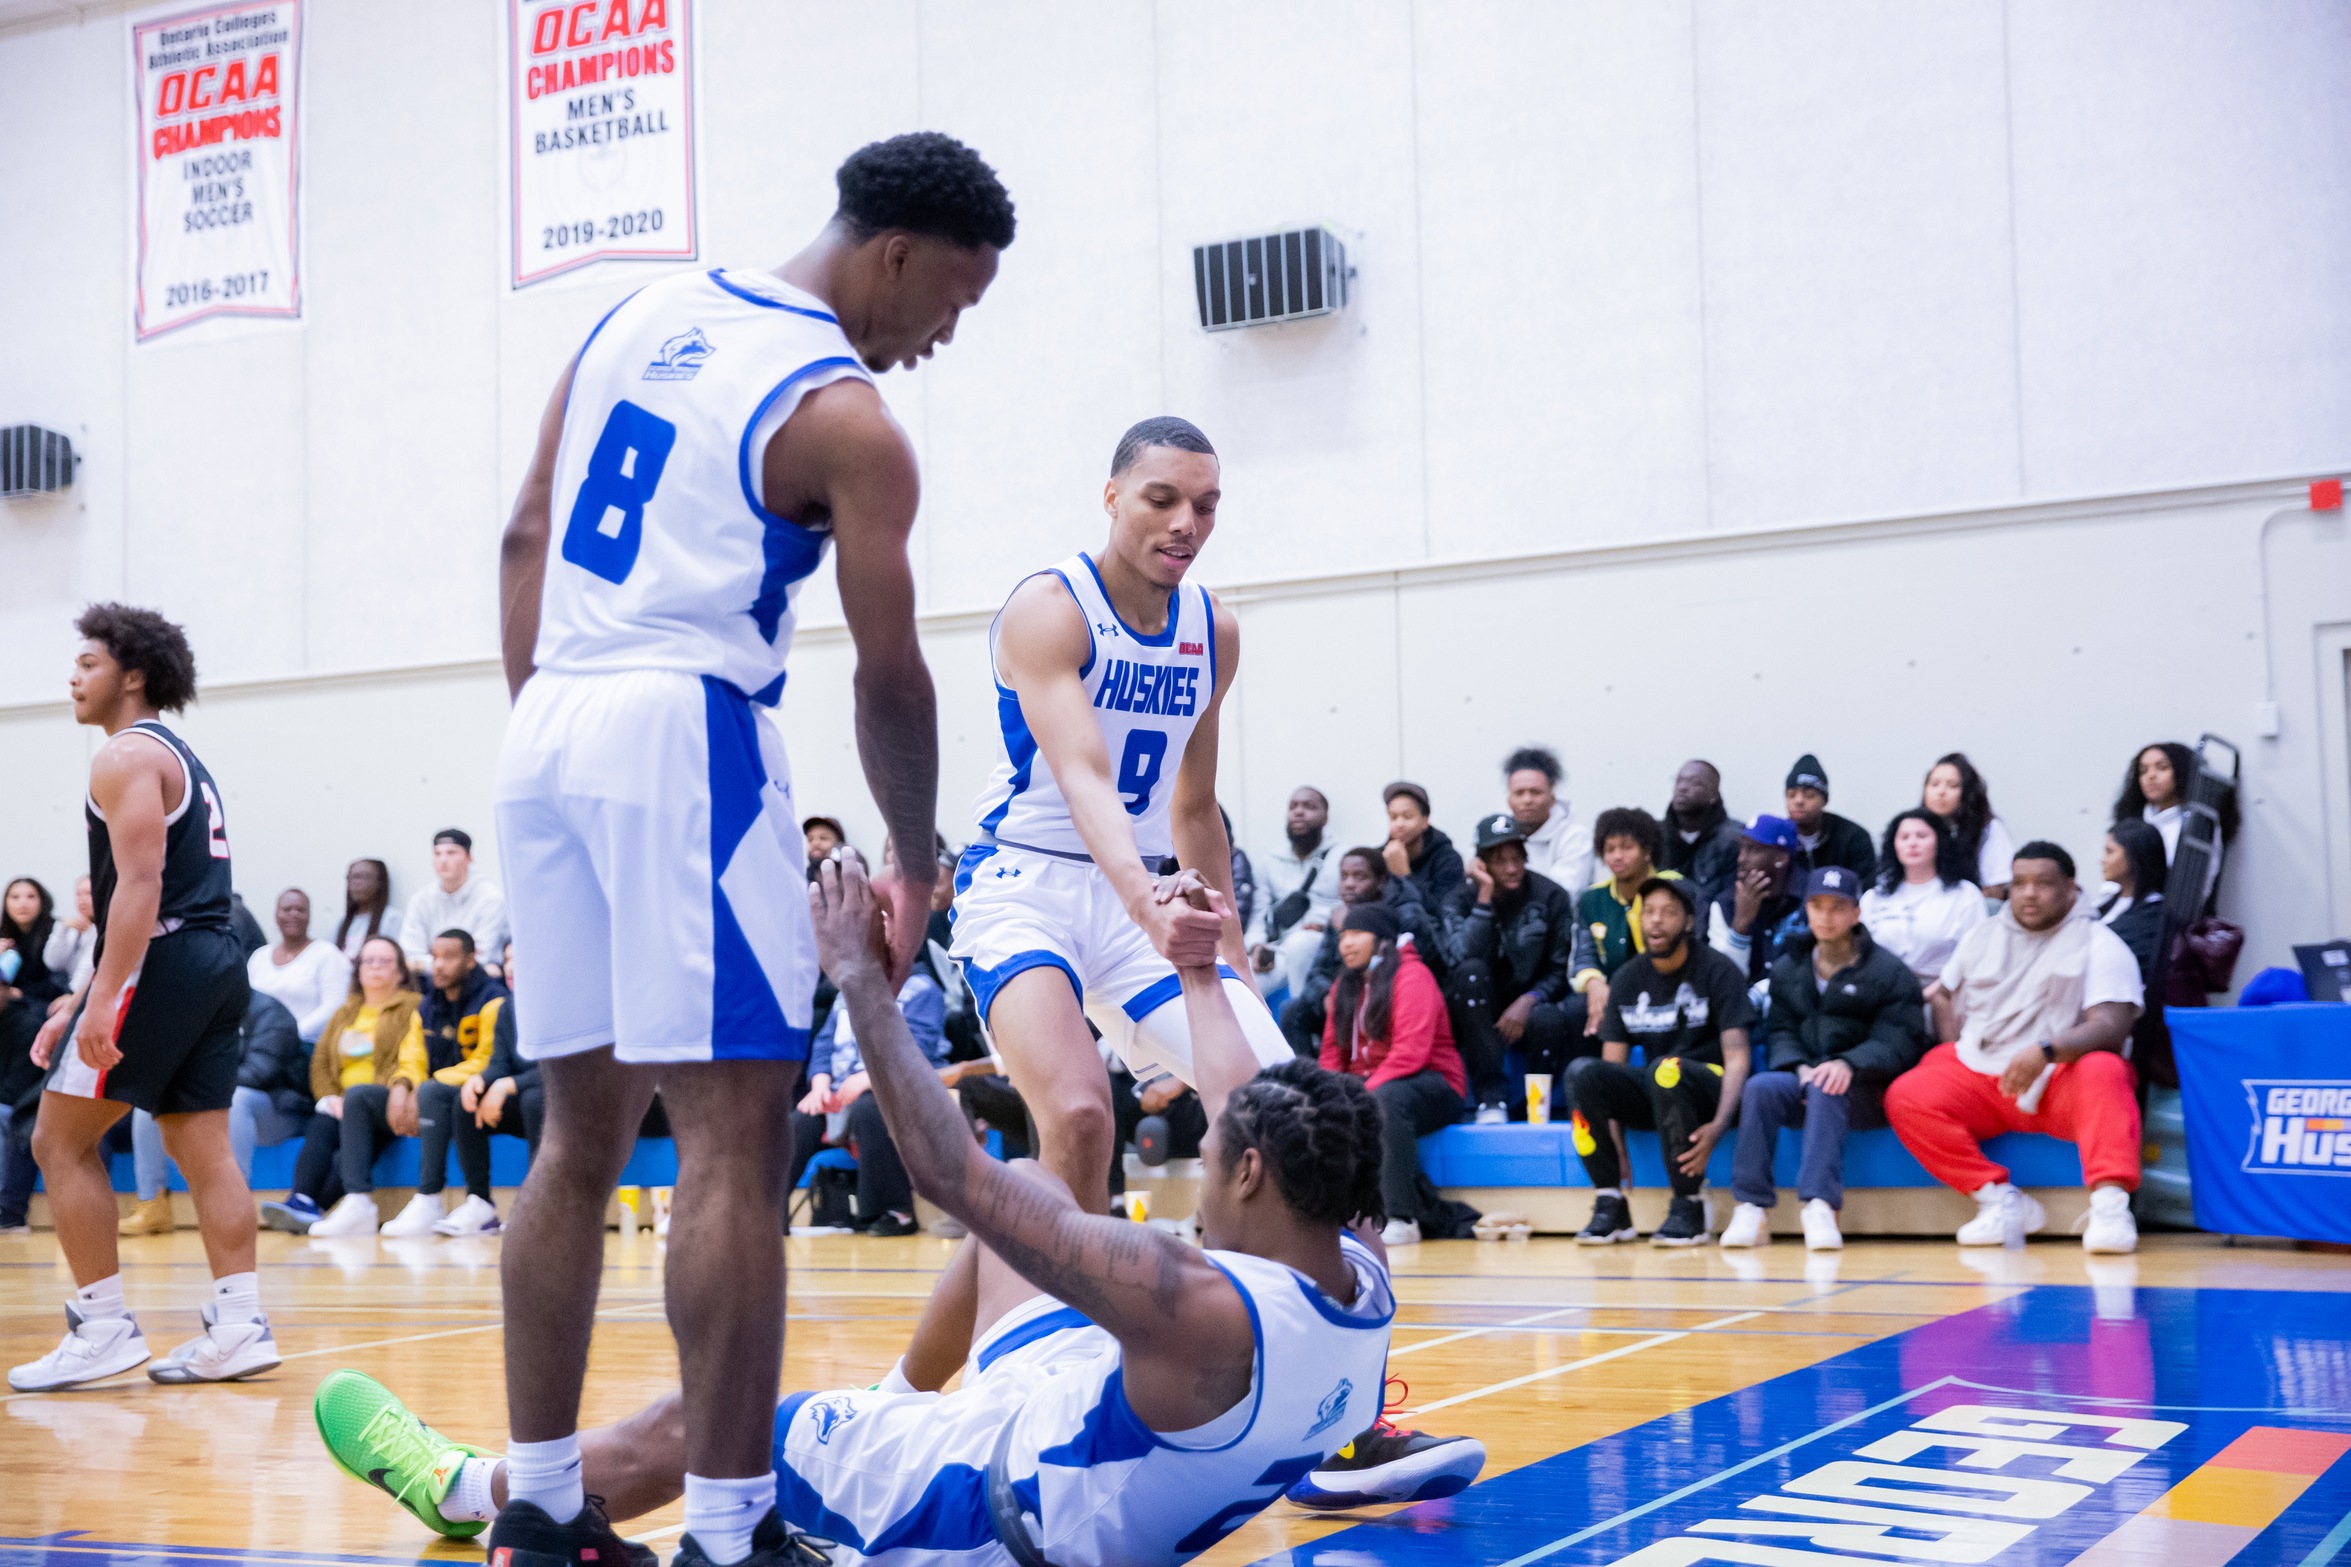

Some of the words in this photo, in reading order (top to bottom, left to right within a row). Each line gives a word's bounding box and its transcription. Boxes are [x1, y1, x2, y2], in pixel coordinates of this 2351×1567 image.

[532, 0, 668, 55] OCAA
[157, 55, 278, 117] OCAA
[527, 39, 675, 100] CHAMPIONS
[568, 88, 635, 121] MEN'S
[153, 105, 281, 160] CHAMPIONS
[534, 110, 669, 154] BASKETBALL
[183, 150, 252, 181] INDOOR
[192, 176, 243, 205] MEN'S
[184, 201, 252, 233] SOCCER
[543, 209, 663, 249] 2019-2020
[166, 270, 269, 307] 2016-2017
[562, 399, 677, 586] 8
[1179, 642, 1204, 656] OCAA
[1093, 658, 1200, 717] HUSKIES
[1117, 728, 1168, 816] 9
